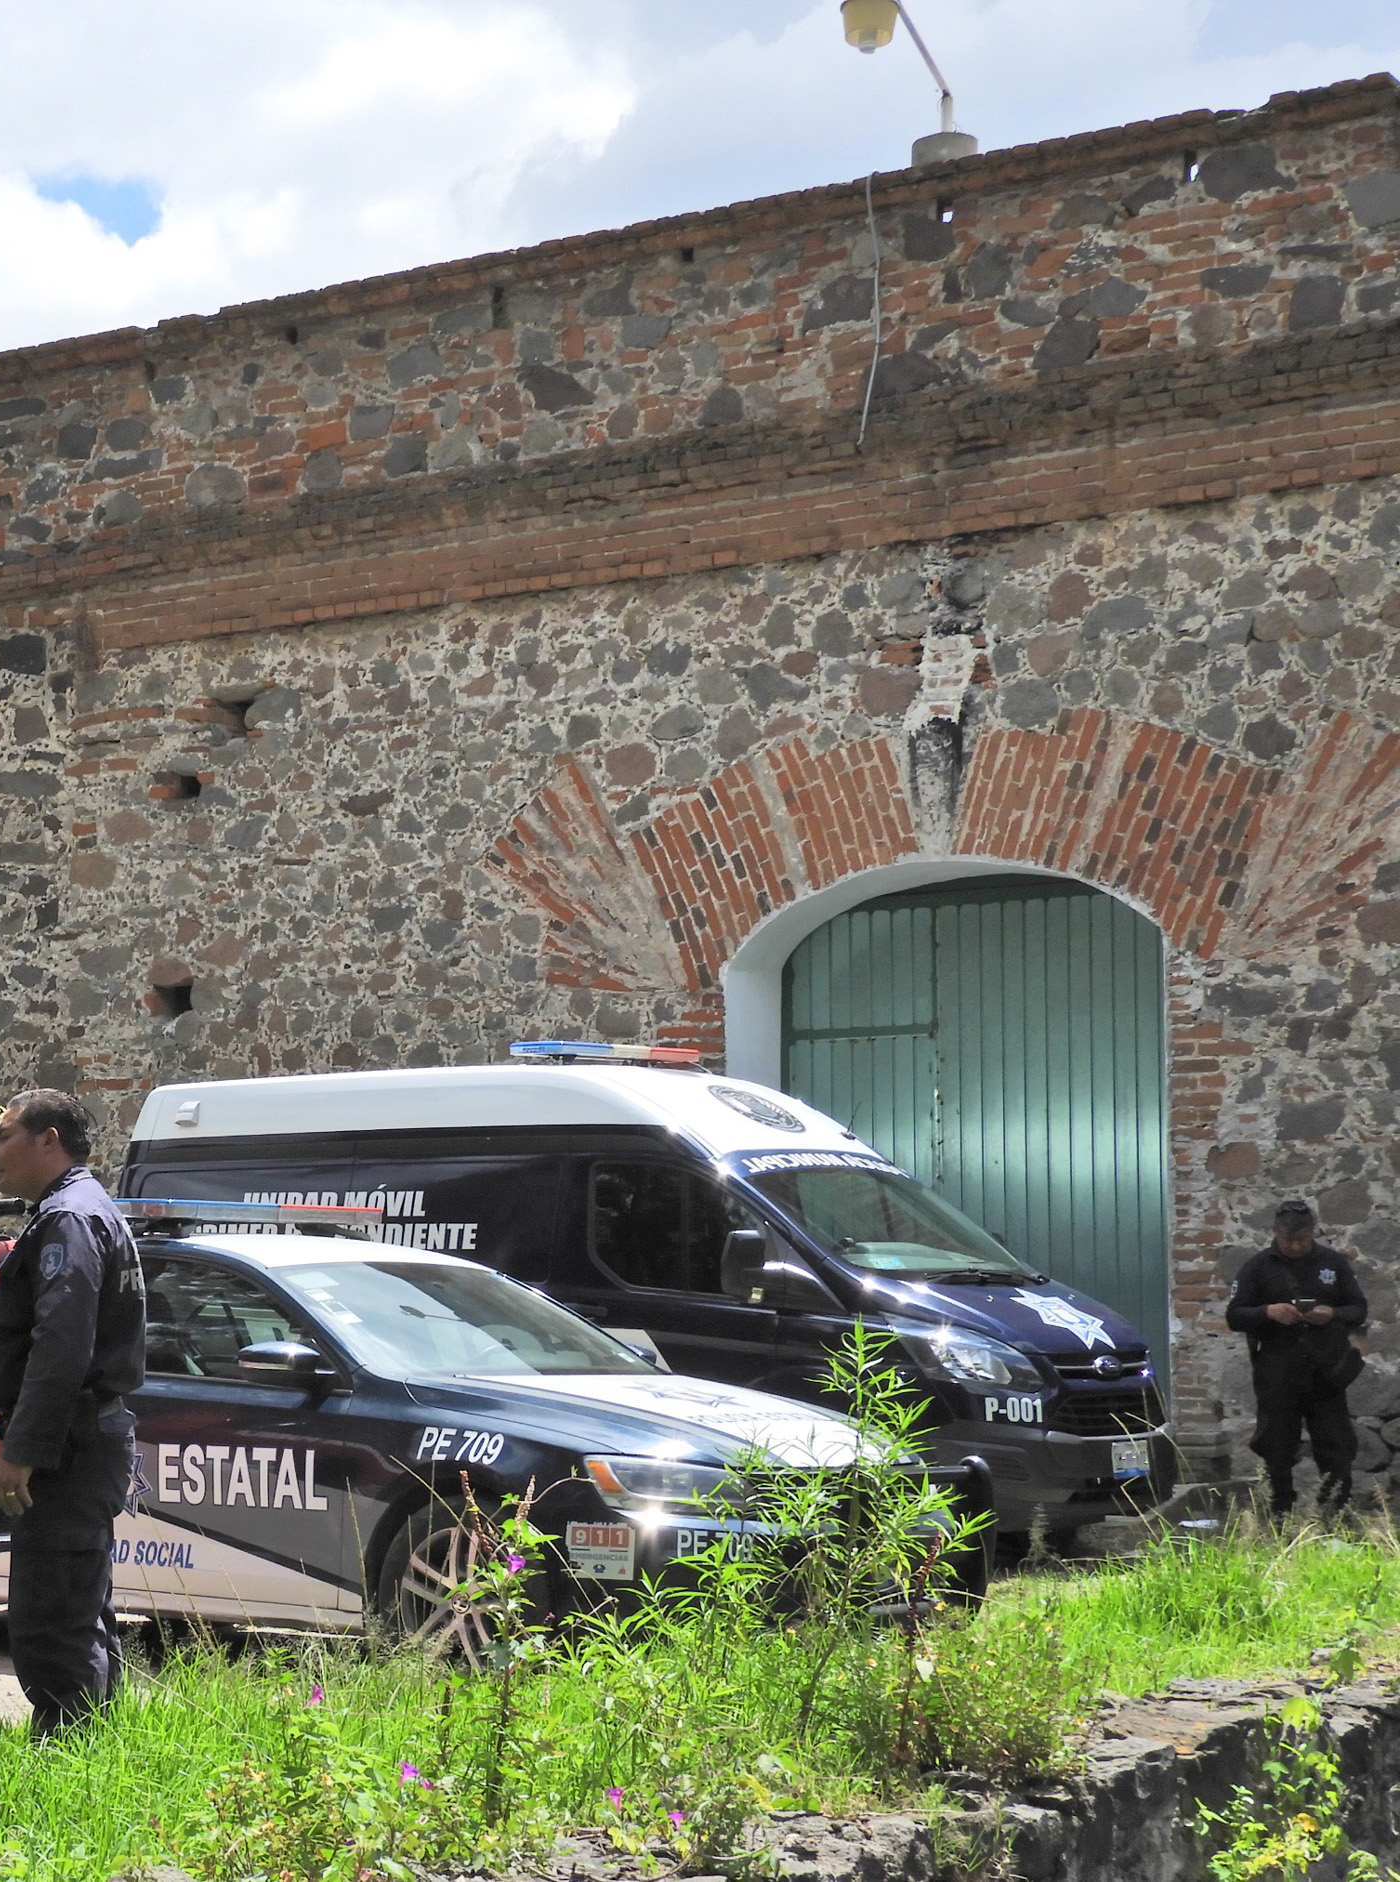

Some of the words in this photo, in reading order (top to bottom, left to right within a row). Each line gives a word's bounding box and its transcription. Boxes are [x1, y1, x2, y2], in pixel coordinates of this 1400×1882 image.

[344, 1184, 426, 1217] MÓVIL
[984, 1397, 1044, 1424] P-001
[416, 1426, 458, 1461] PE
[454, 1429, 505, 1465] 709
[158, 1443, 329, 1511] ESTATAL
[575, 1529, 624, 1545] 911
[677, 1529, 709, 1559] PE
[133, 1540, 195, 1569] SOCIAL
